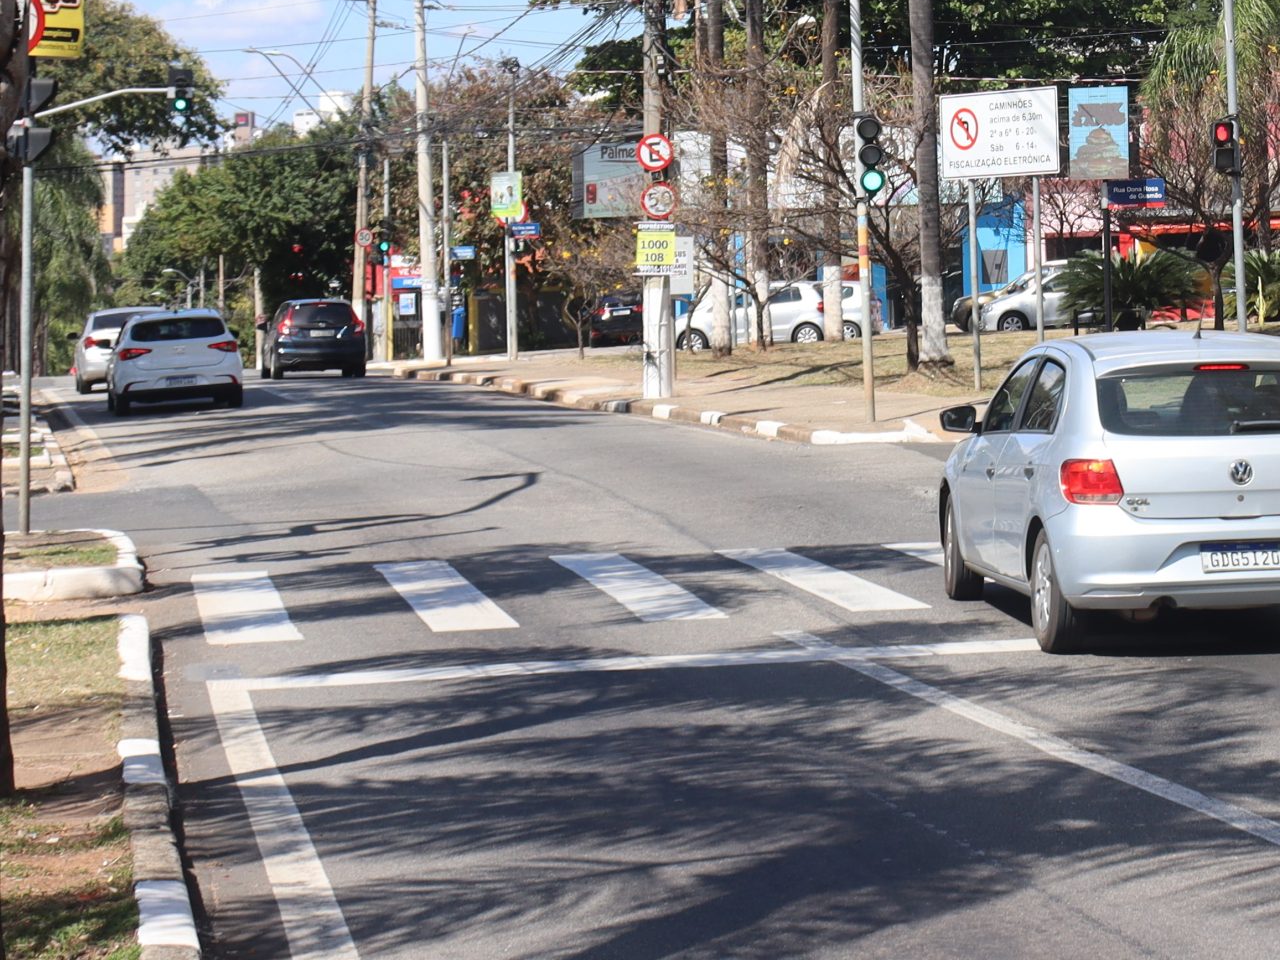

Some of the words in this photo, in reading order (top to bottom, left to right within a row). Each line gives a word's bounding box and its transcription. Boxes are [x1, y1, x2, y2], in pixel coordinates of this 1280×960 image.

[989, 99, 1033, 111] CAMINHÕES
[989, 115, 1010, 124] acima
[1012, 113, 1020, 122] de
[601, 145, 637, 159] Palme
[949, 157, 1002, 169] FISCALIZAÇÃO
[1004, 154, 1051, 166] ELETRÔNICA
[645, 253, 664, 262] 108
